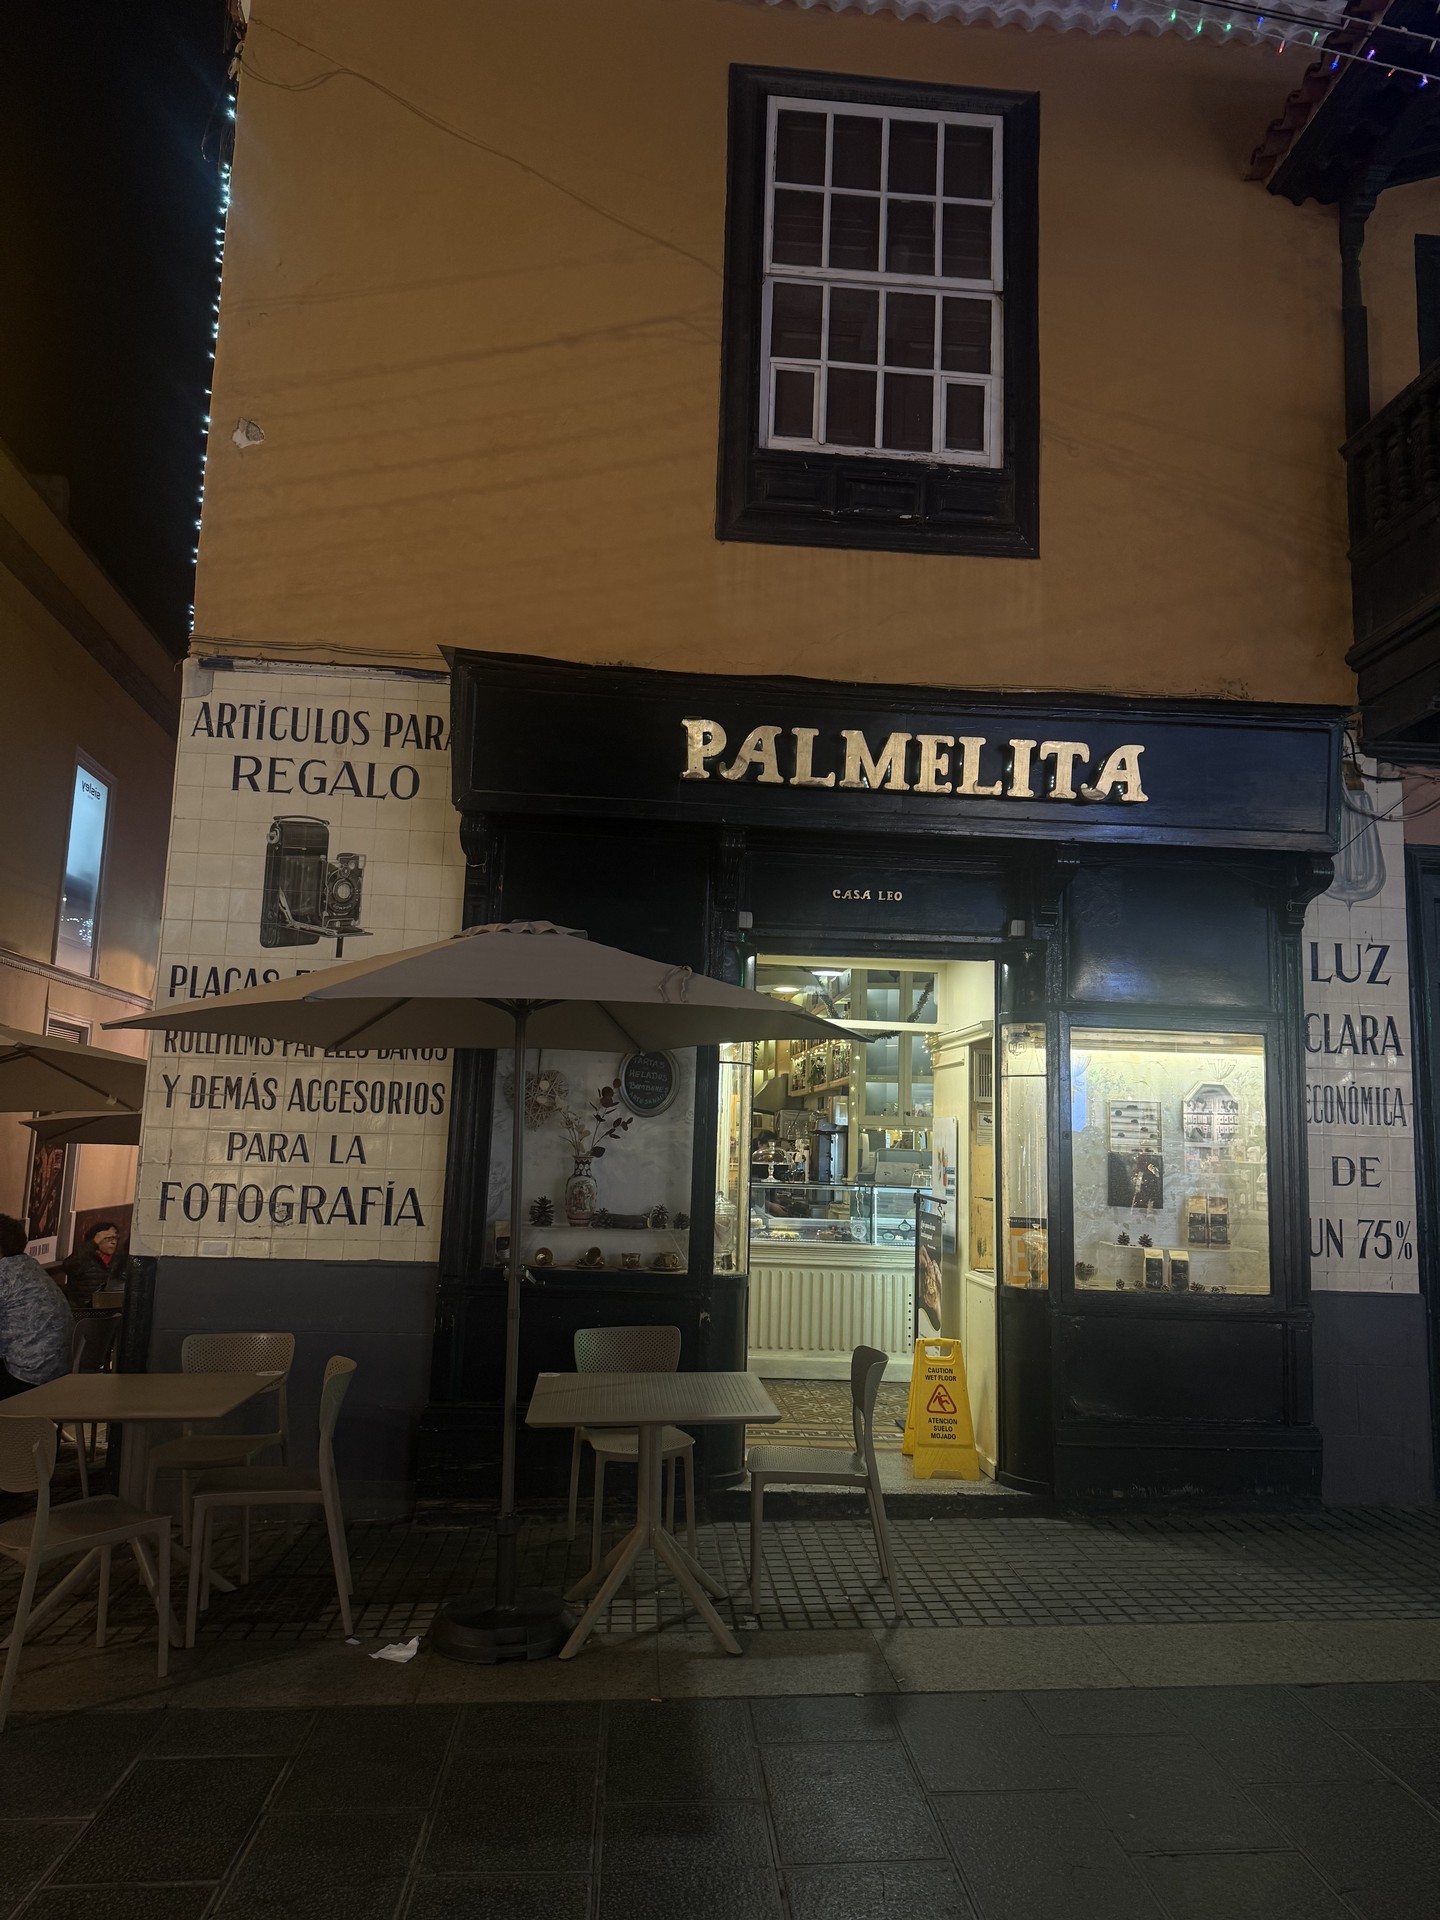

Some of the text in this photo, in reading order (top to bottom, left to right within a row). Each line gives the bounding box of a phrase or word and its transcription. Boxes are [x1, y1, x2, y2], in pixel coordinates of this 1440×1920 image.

[191, 700, 370, 747] ARTÍCULOS
[231, 755, 420, 801] REGALO
[680, 716, 1149, 802] PALMELITA
[832, 889, 903, 901] CASA LEO
[1310, 942, 1391, 986] LUZ
[1304, 1013, 1404, 1057] CLARA
[162, 1072, 445, 1116] Y DEMÁS ACCESORIOS
[629, 1069, 668, 1082] HELADOS
[227, 1132, 367, 1165] PARA LA
[1331, 1156, 1382, 1188] DE
[158, 1181, 425, 1227] FOTOGRAFÍA
[1309, 1218, 1413, 1261] UN 75%
